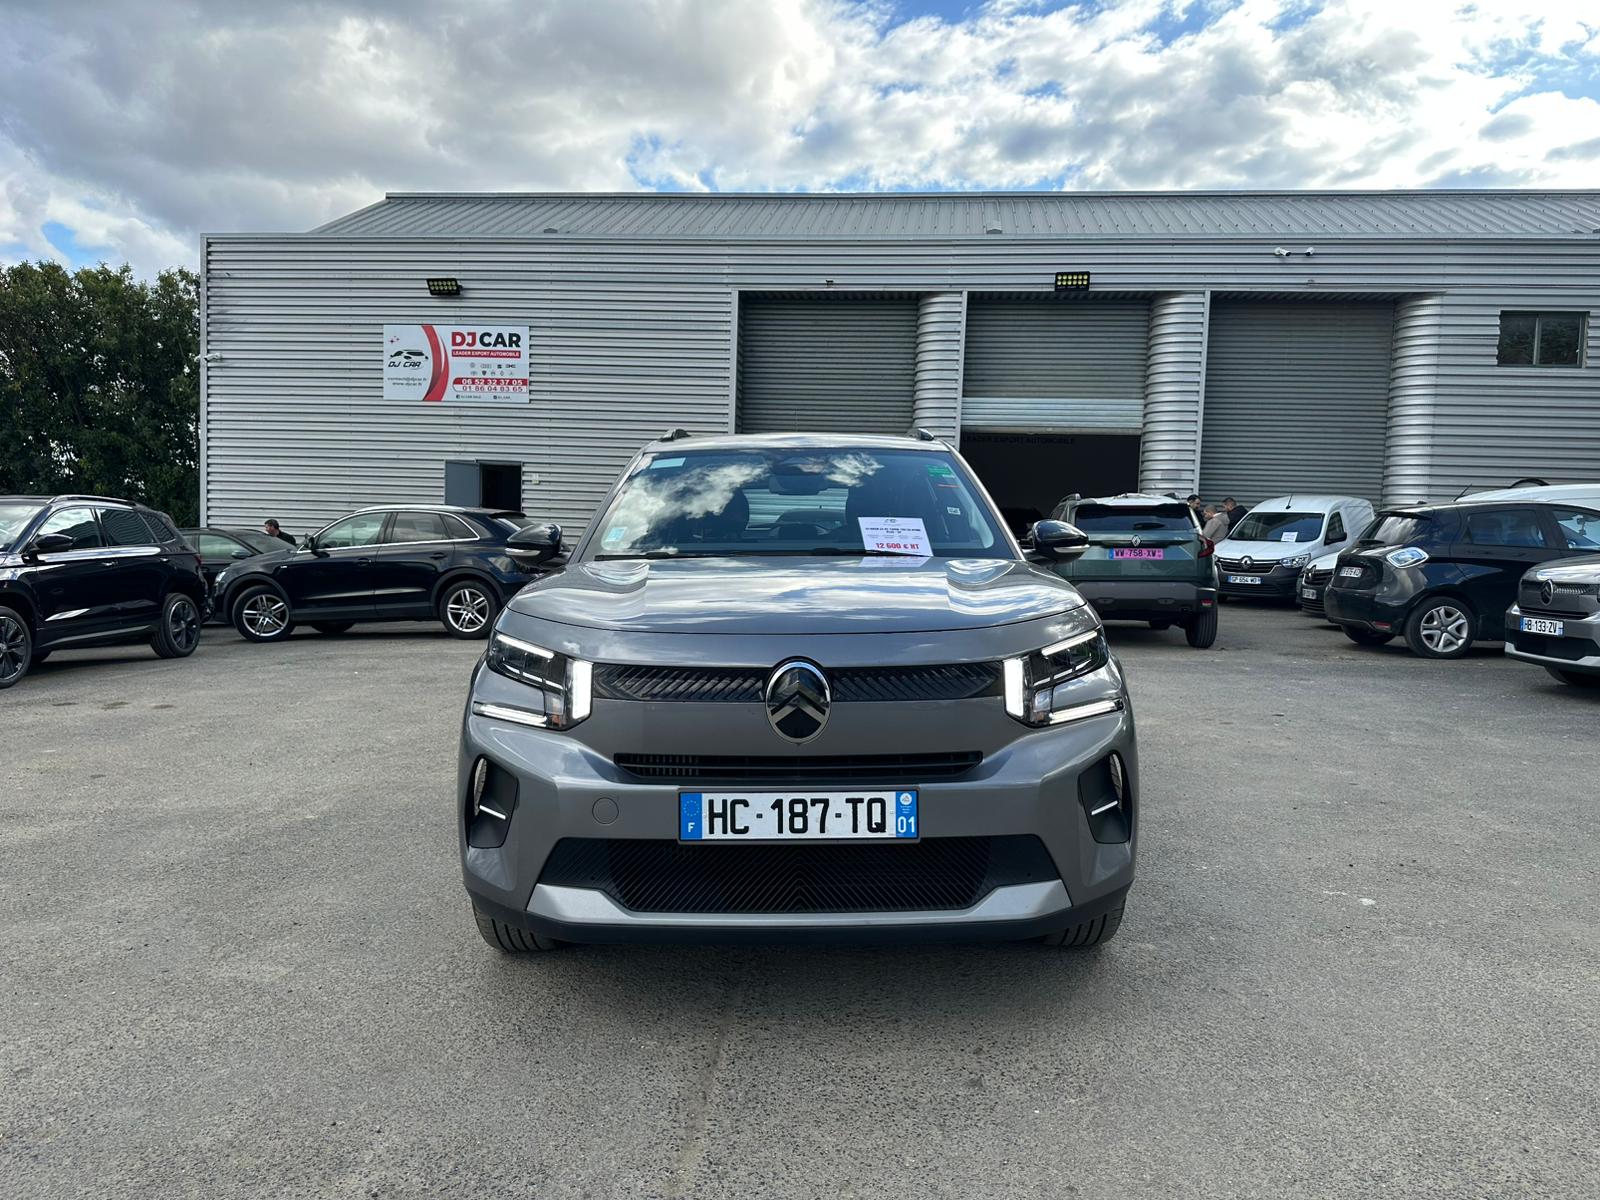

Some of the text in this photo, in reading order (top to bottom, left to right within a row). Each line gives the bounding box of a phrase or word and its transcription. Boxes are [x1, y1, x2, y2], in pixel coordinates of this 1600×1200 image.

[451, 332, 521, 348] DJ CAR
[708, 797, 887, 835] HC-187-TQ
[687, 822, 695, 833] F
[897, 816, 915, 833] 01
